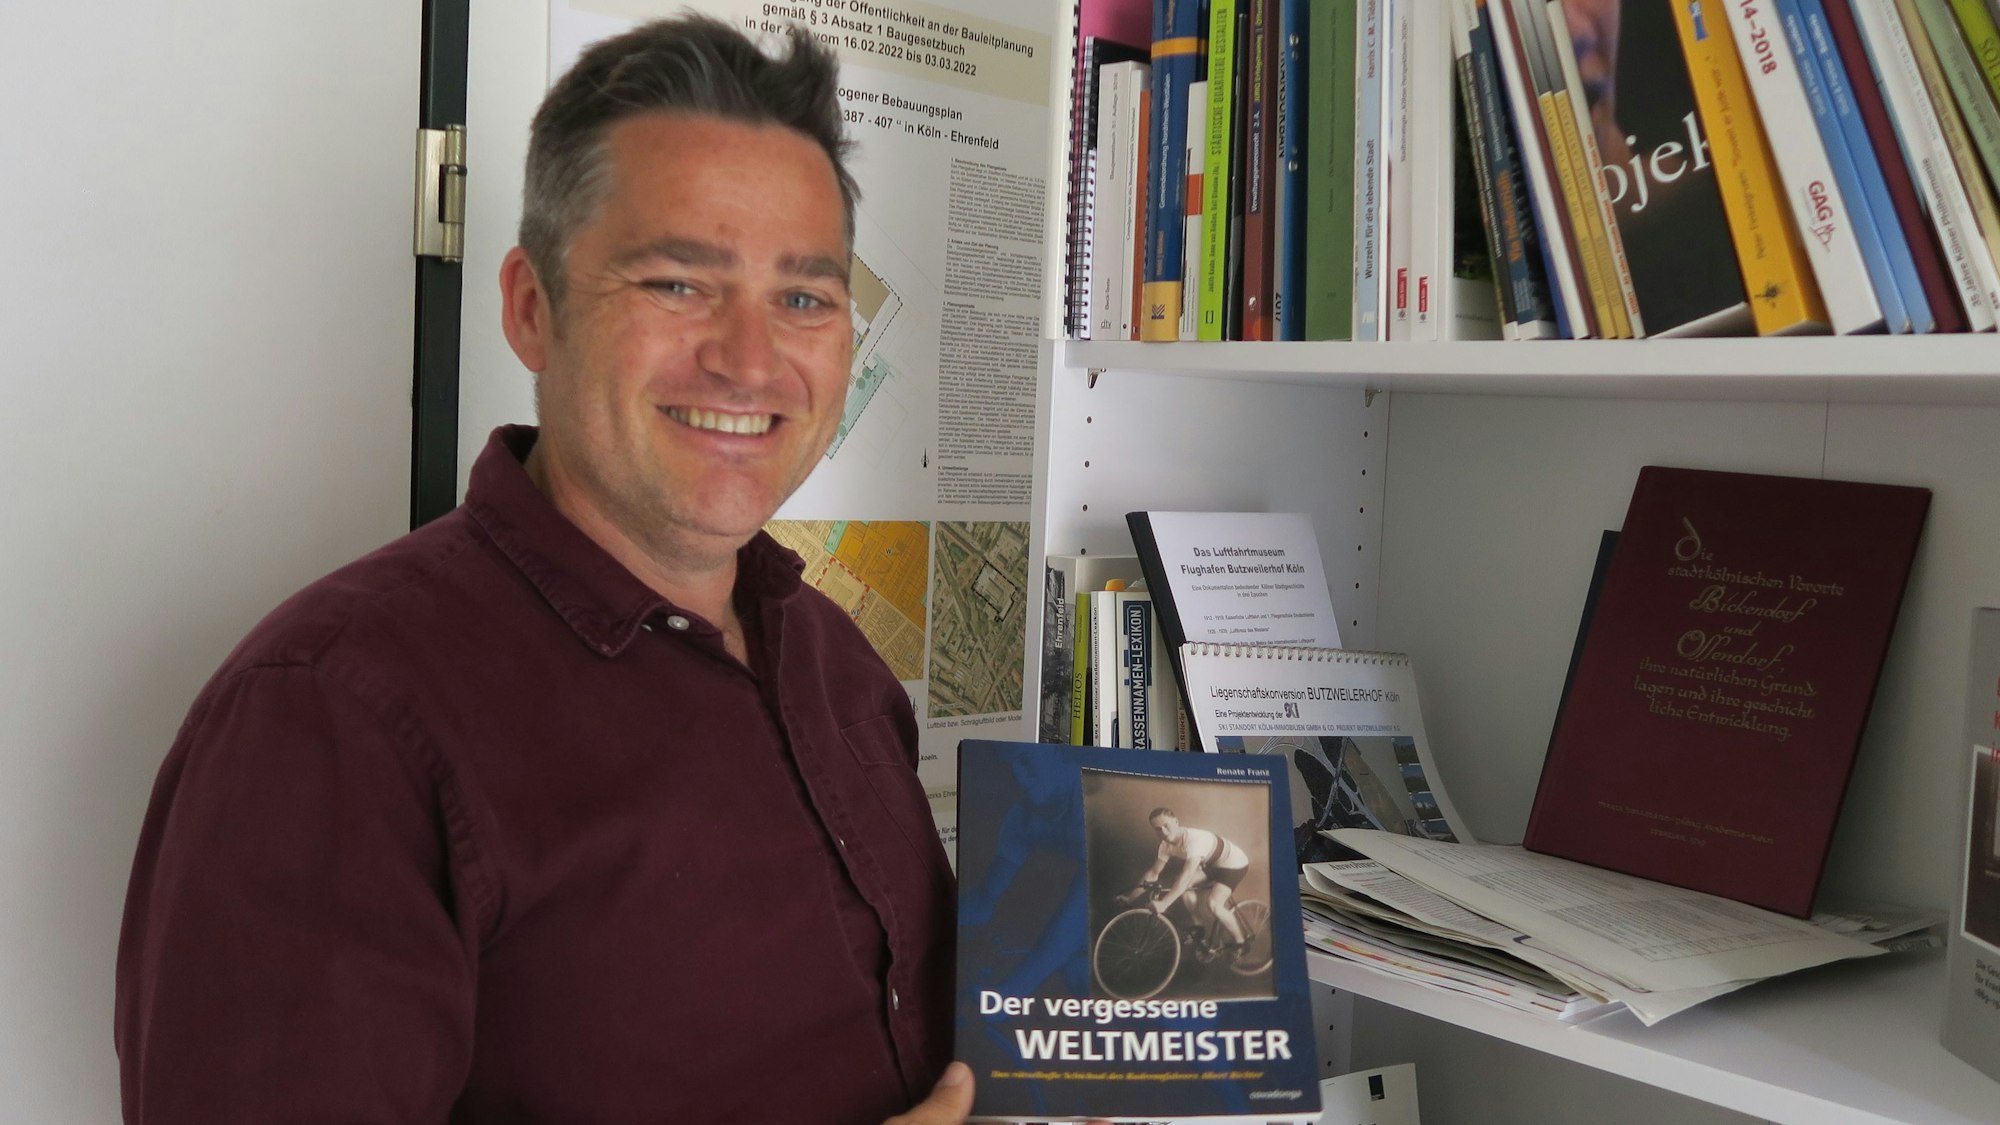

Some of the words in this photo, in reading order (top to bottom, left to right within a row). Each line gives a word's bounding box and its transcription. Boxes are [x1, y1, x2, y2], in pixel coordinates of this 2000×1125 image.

[745, 16, 756, 29] in
[760, 20, 782, 34] der
[813, 32, 840, 45] vom
[844, 36, 904, 59] 16.02.2022
[906, 49, 922, 64] bis
[925, 54, 977, 77] 03.03.2022
[763, 3, 806, 21] gemäß
[810, 10, 818, 25] §
[821, 13, 828, 24] 3
[831, 15, 873, 35] Absatz
[877, 24, 883, 36] 1
[886, 26, 966, 57] Baugesetzbuch
[927, 21, 940, 31] an
[942, 22, 959, 36] der
[961, 27, 1034, 58] Bauleitplanung
[1216, 8, 1227, 55] GESTALTEN
[882, 93, 963, 122] Bebauungsplan
[843, 109, 865, 124] 387
[874, 115, 893, 130] 407
[904, 120, 914, 134] in
[917, 123, 941, 141] Köln
[950, 130, 999, 150] Ehrenfeld
[1210, 106, 1223, 155] STÄDTISCHE
[1367, 139, 1375, 165] Stadt
[1600, 110, 1709, 212] ojek
[1808, 180, 1833, 221] GAG
[1922, 157, 1951, 226] Philharmonie
[1366, 225, 1374, 239] für
[1755, 231, 1768, 260] Peter
[1948, 224, 1965, 262] Kölner
[1365, 240, 1373, 280] Wurzeln
[1960, 261, 1977, 291] Jahre
[1100, 319, 1112, 330] dtv
[1193, 547, 1211, 557] Das
[1214, 547, 1286, 557] Luftfahrtmuseum
[1675, 516, 1713, 561] Die
[1180, 564, 1226, 576] Flughafen
[1227, 563, 1285, 574] Butzweilerhof
[1286, 564, 1305, 574] Köln
[1667, 563, 1783, 589] stadtkölnischen
[1789, 574, 1845, 596] Vororte
[1689, 584, 1818, 623] Bickendorf
[1055, 597, 1065, 649] Ehrenfeld
[1723, 620, 1762, 637] und
[1129, 608, 1146, 749] RASSENNAMEN-LEXIKON
[1639, 656, 1666, 673] ihre
[1670, 666, 1759, 689] natürlichen
[1073, 672, 1083, 720] HELIOS
[1210, 685, 1306, 700] Liegenschaftskonversion
[1307, 687, 1383, 701] BUTZWEILERHOF
[1385, 691, 1400, 701] Köln
[1634, 675, 1675, 700] lagen
[1678, 685, 1708, 701] und
[1710, 688, 1742, 706] ihre
[927, 720, 947, 729] Luftbild
[1215, 710, 1227, 718] Eine
[1228, 710, 1275, 720] Projektentwicklung
[1275, 711, 1284, 719] der
[1648, 697, 1685, 718] liche
[1686, 704, 1793, 743] Entwicklung.
[1216, 767, 1245, 776] Renate
[1247, 767, 1270, 776] Franz
[979, 990, 1034, 1017] Der
[1044, 996, 1218, 1024] vergessene
[1015, 1029, 1292, 1062] WELTMEISTER
